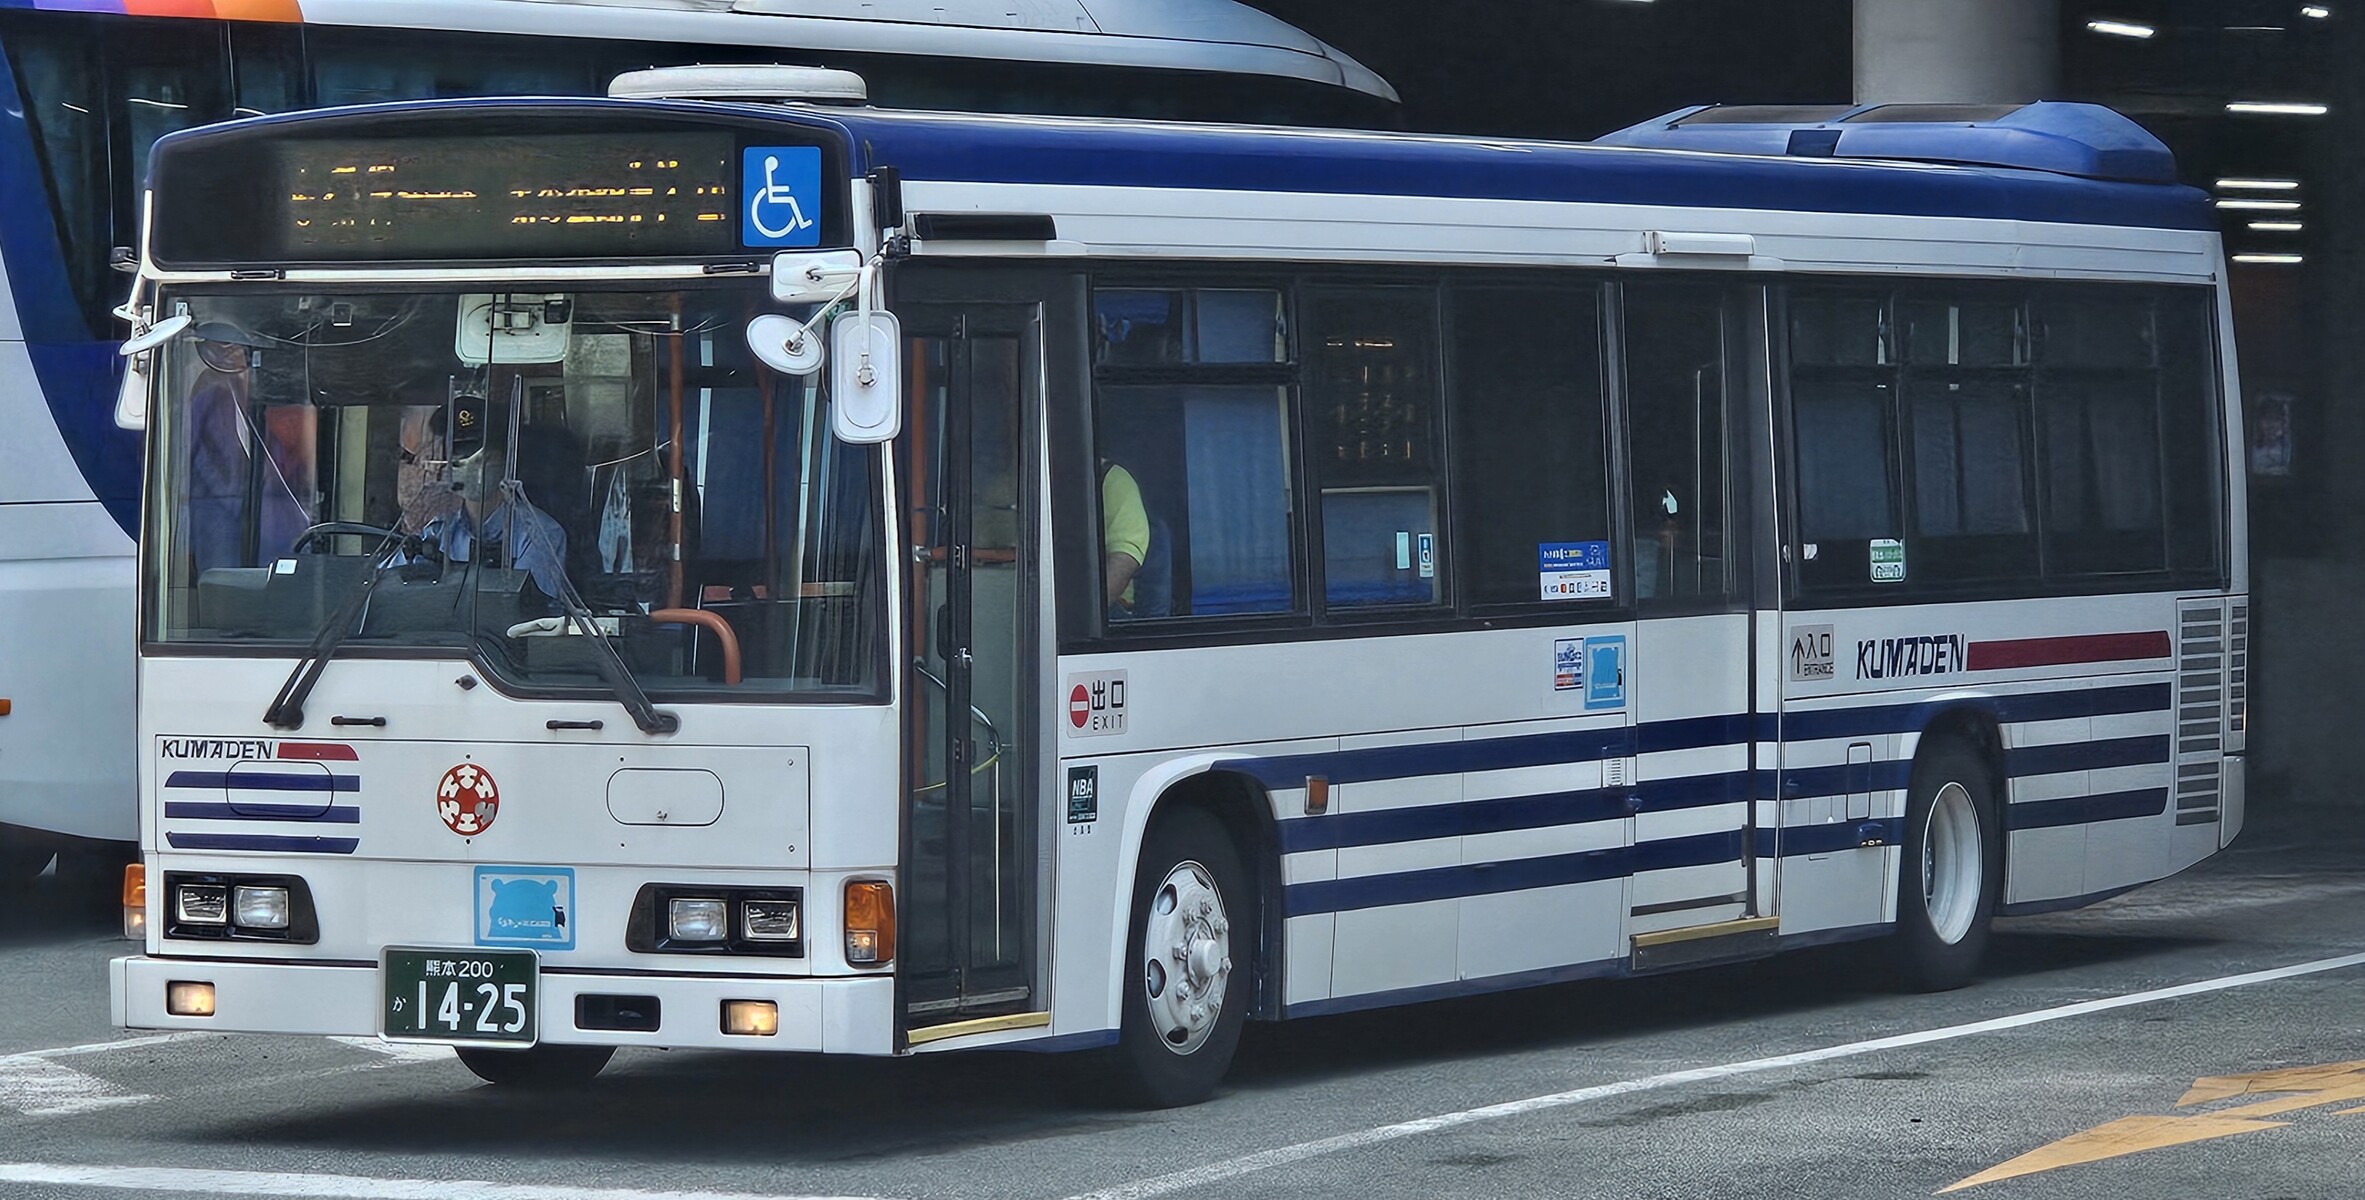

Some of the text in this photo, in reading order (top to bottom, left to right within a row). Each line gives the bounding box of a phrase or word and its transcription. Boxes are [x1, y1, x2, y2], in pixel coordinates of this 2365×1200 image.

[1806, 633, 1831, 659] 入口
[1856, 633, 1965, 680] KUMADEN
[1091, 680, 1125, 711] 出口
[1092, 713, 1124, 730] EXIT
[161, 739, 273, 760] KUMADEN
[1072, 778, 1094, 796] NBA
[417, 980, 527, 1033] 14-25
